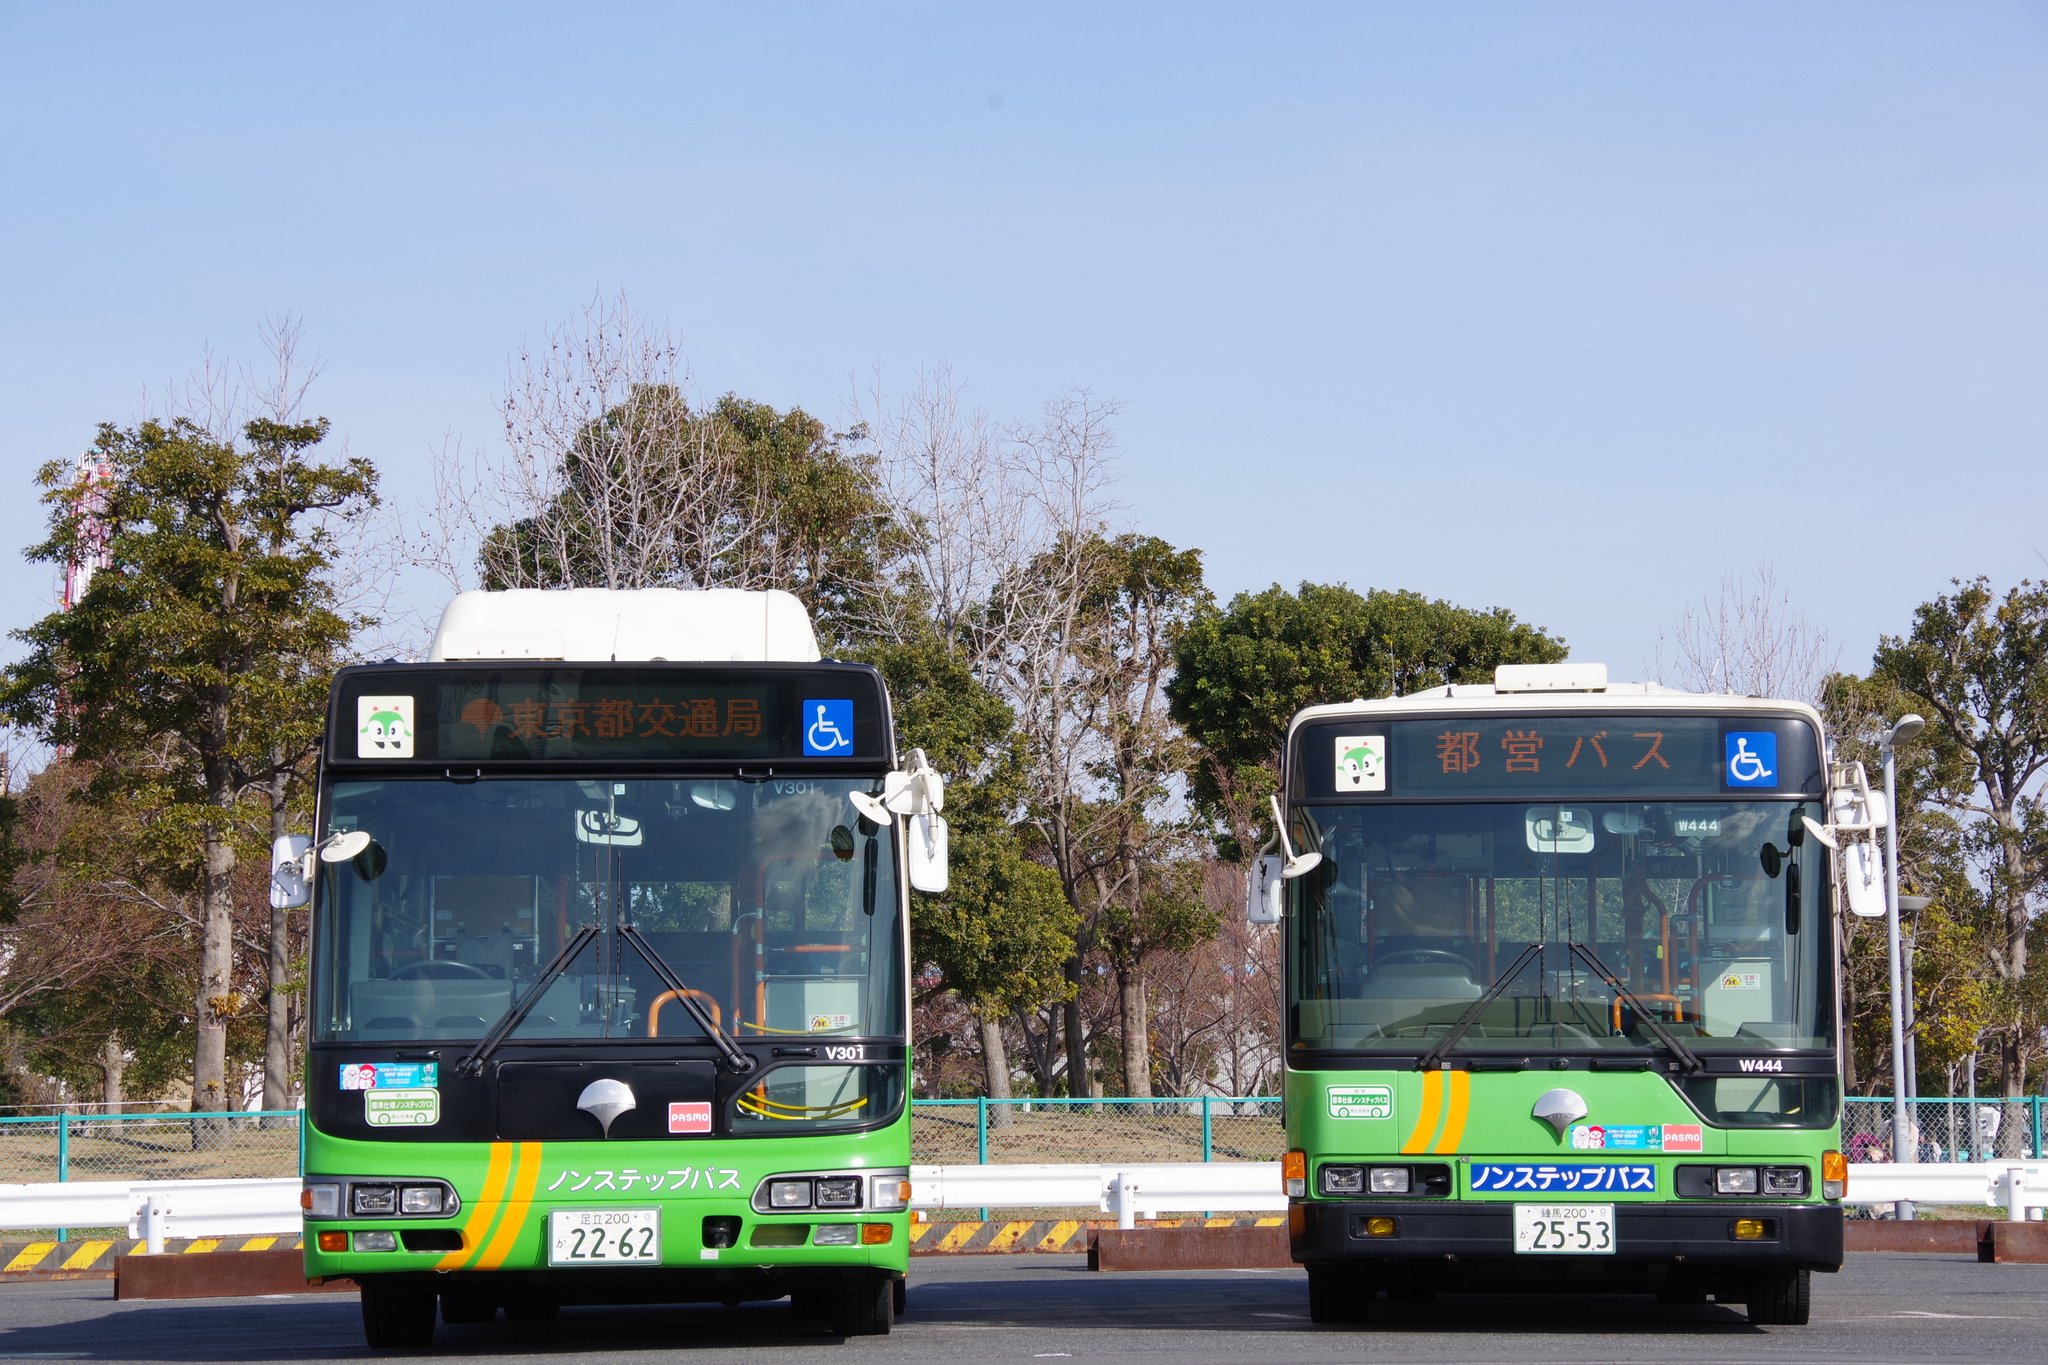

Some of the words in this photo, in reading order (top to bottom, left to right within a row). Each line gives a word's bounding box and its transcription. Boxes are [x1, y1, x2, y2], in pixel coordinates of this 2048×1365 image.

[507, 698, 761, 738] 東京都交通局
[1436, 730, 1670, 774] 都営バス
[774, 782, 815, 795] V301
[1679, 820, 1718, 831] W444
[825, 1046, 864, 1060] V301
[1739, 1059, 1783, 1072] W444
[671, 1113, 709, 1122] PASMO
[1664, 1133, 1700, 1142] PASMO
[547, 1166, 741, 1192] ノンステップバス
[1471, 1166, 1654, 1190] ノンステップバス
[1520, 1231, 1529, 1239] か
[1533, 1221, 1610, 1249] 25-53
[556, 1239, 566, 1249] か
[570, 1227, 654, 1258] 22-62
